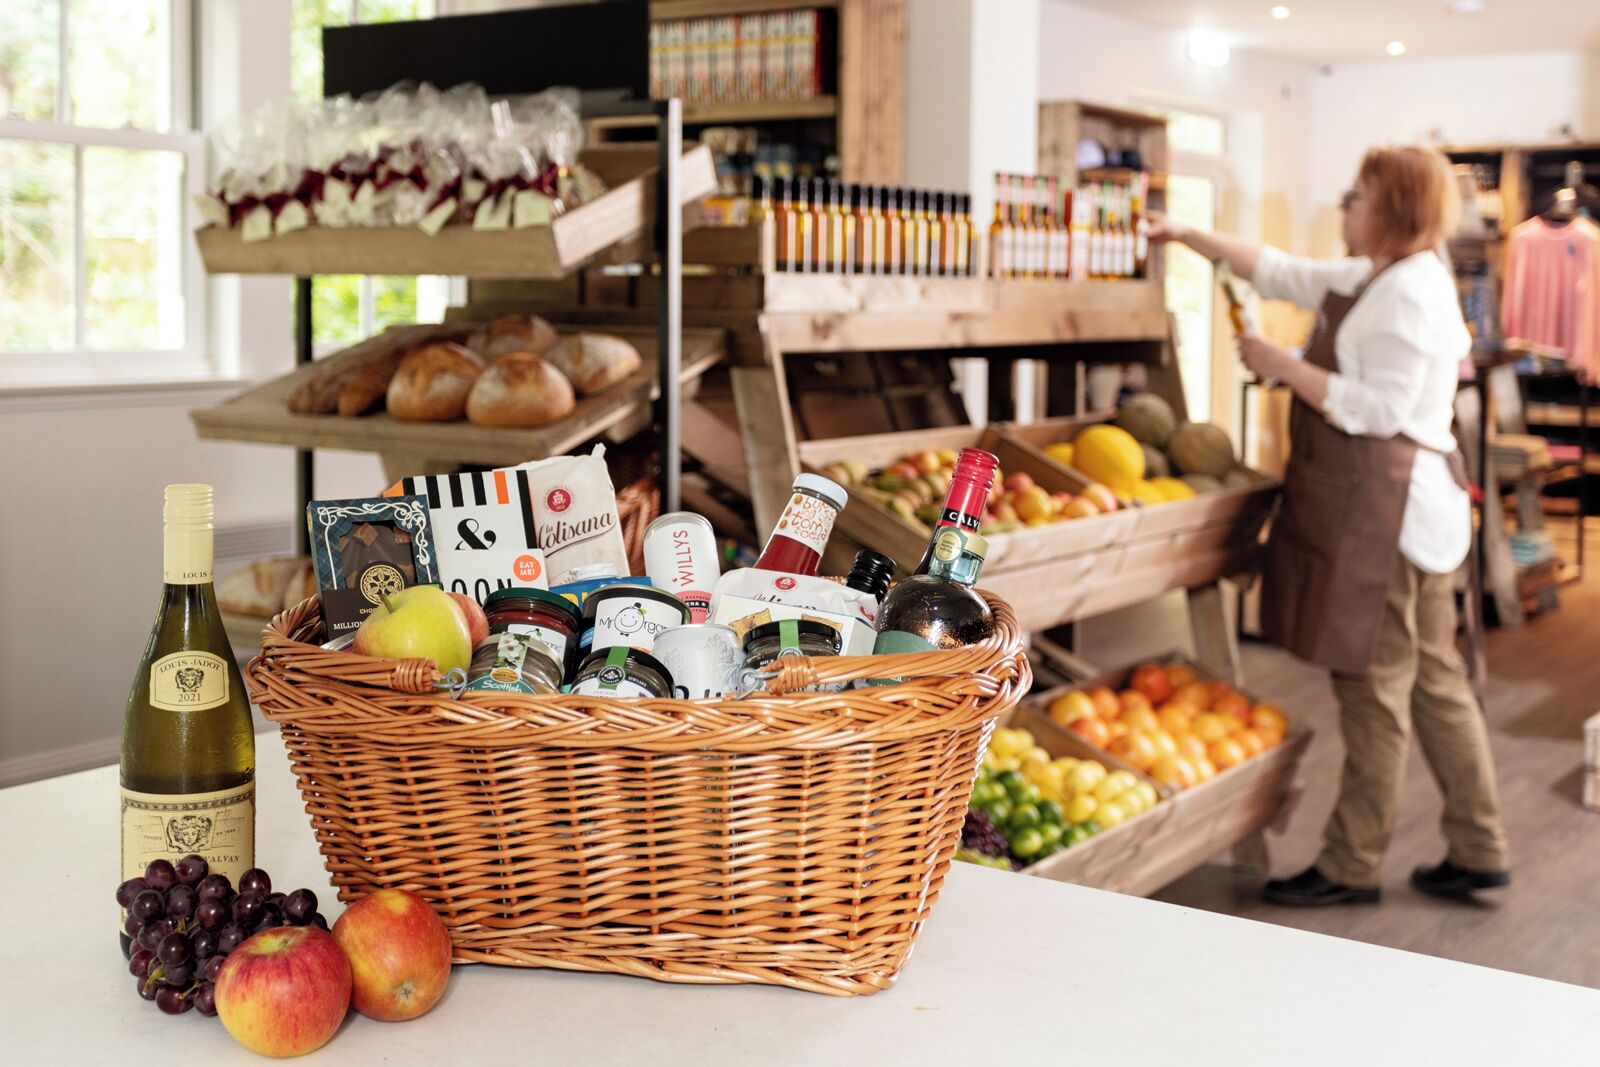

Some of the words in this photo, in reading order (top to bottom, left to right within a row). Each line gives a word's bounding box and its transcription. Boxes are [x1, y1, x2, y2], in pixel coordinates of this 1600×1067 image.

[948, 512, 979, 528] CALV
[454, 518, 496, 550] &
[538, 512, 612, 550] Colisana
[672, 530, 694, 586] WILLYS
[183, 571, 208, 579] LOUIS
[520, 568, 536, 576] ME!
[160, 660, 188, 672] LOUIS
[190, 659, 221, 670] JADOT
[178, 692, 201, 702] 2021
